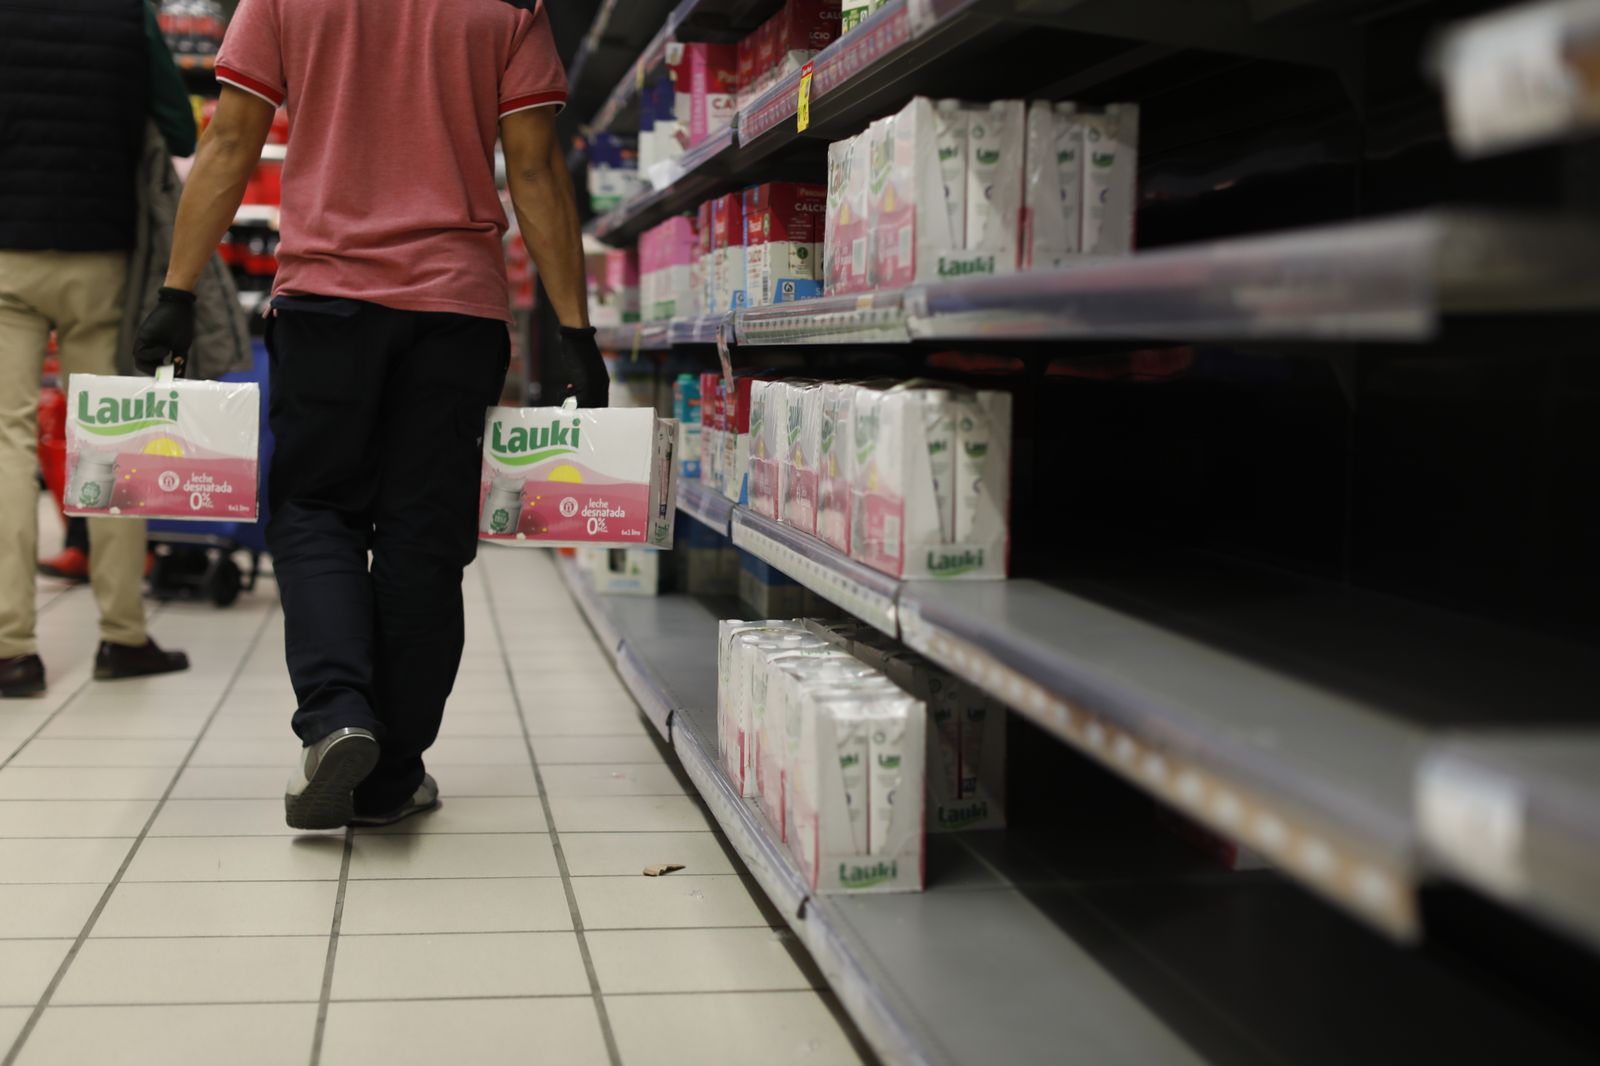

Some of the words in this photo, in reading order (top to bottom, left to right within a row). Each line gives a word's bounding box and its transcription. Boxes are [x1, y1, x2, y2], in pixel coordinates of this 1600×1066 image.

[937, 256, 995, 276] Lauki
[78, 390, 179, 425] Lauki
[491, 418, 581, 454] Lauki
[183, 480, 232, 493] desnatada
[191, 472, 213, 483] leche
[581, 505, 625, 518] desnatada
[589, 497, 608, 508] leche
[926, 548, 984, 571] Lauki
[938, 801, 988, 825] Lauki
[838, 861, 898, 882] Lauki
